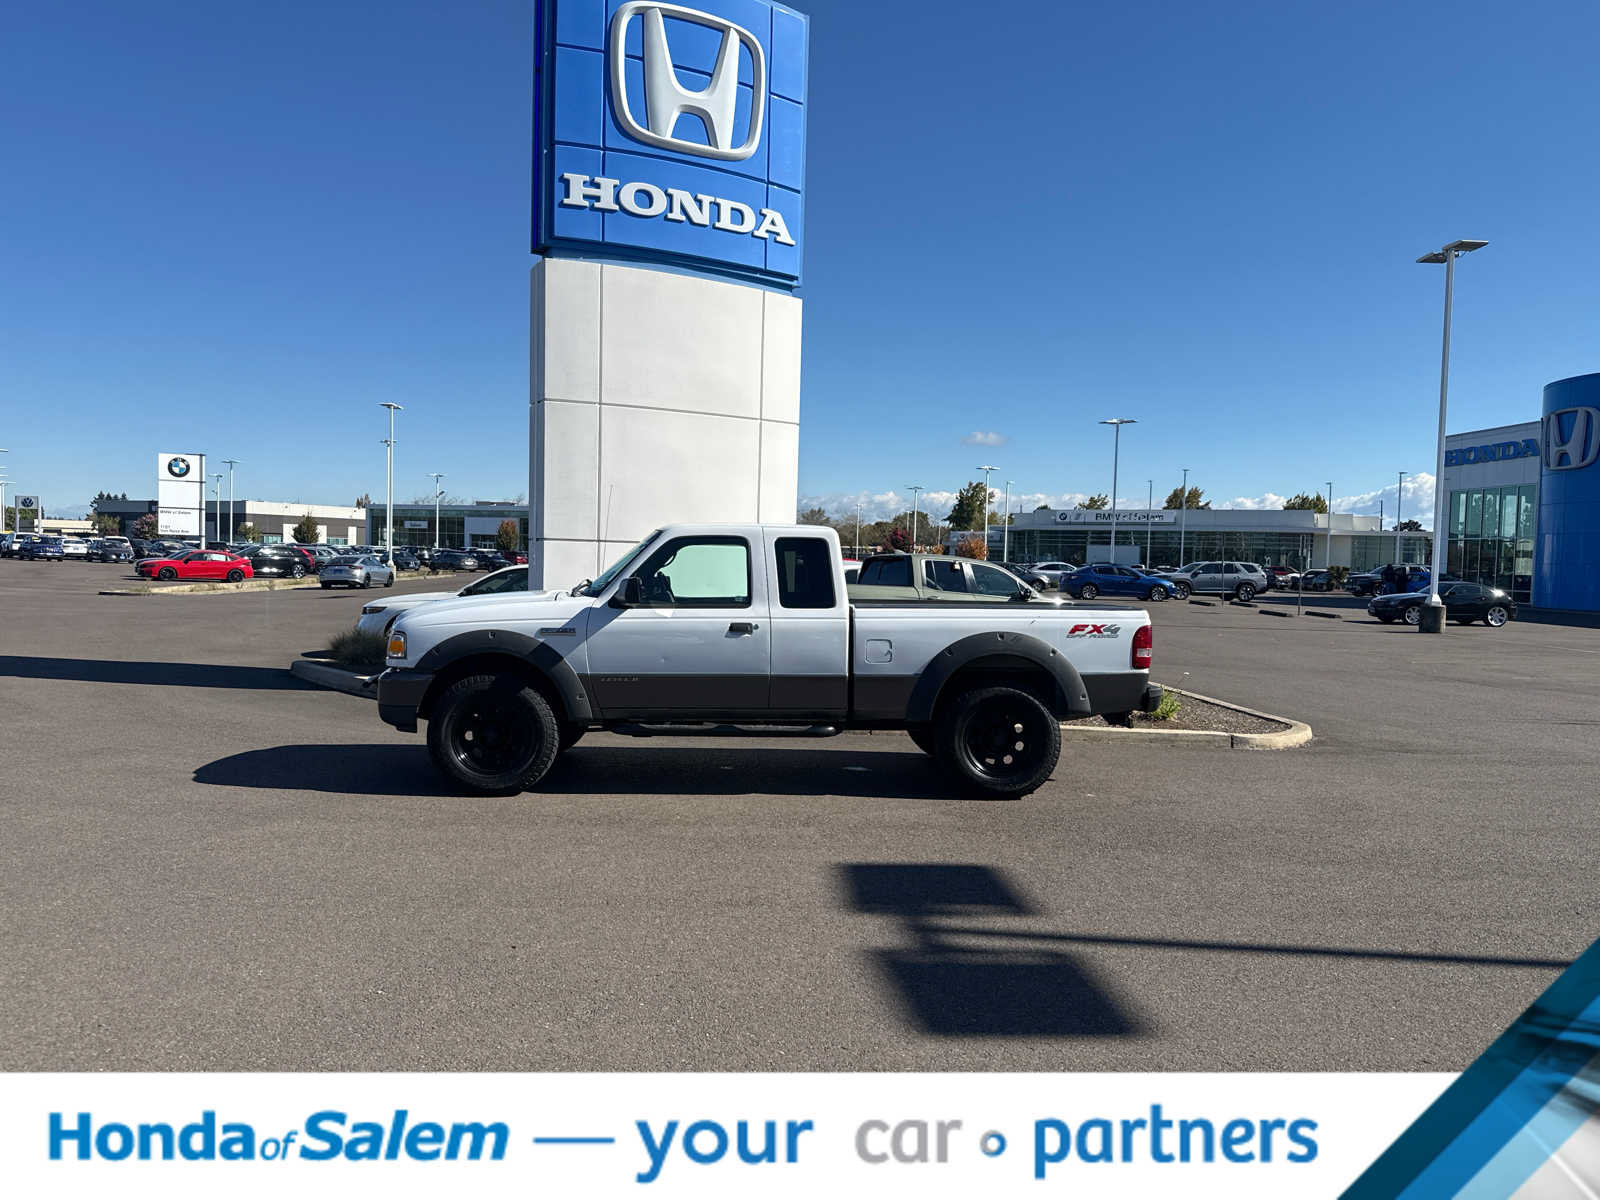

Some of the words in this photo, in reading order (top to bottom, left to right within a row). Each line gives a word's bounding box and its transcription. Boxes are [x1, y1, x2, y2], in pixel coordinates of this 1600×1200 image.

[562, 172, 796, 246] HONDA
[1444, 438, 1541, 467] HONDA
[1095, 512, 1120, 521] BMW
[1068, 624, 1121, 634] FX4
